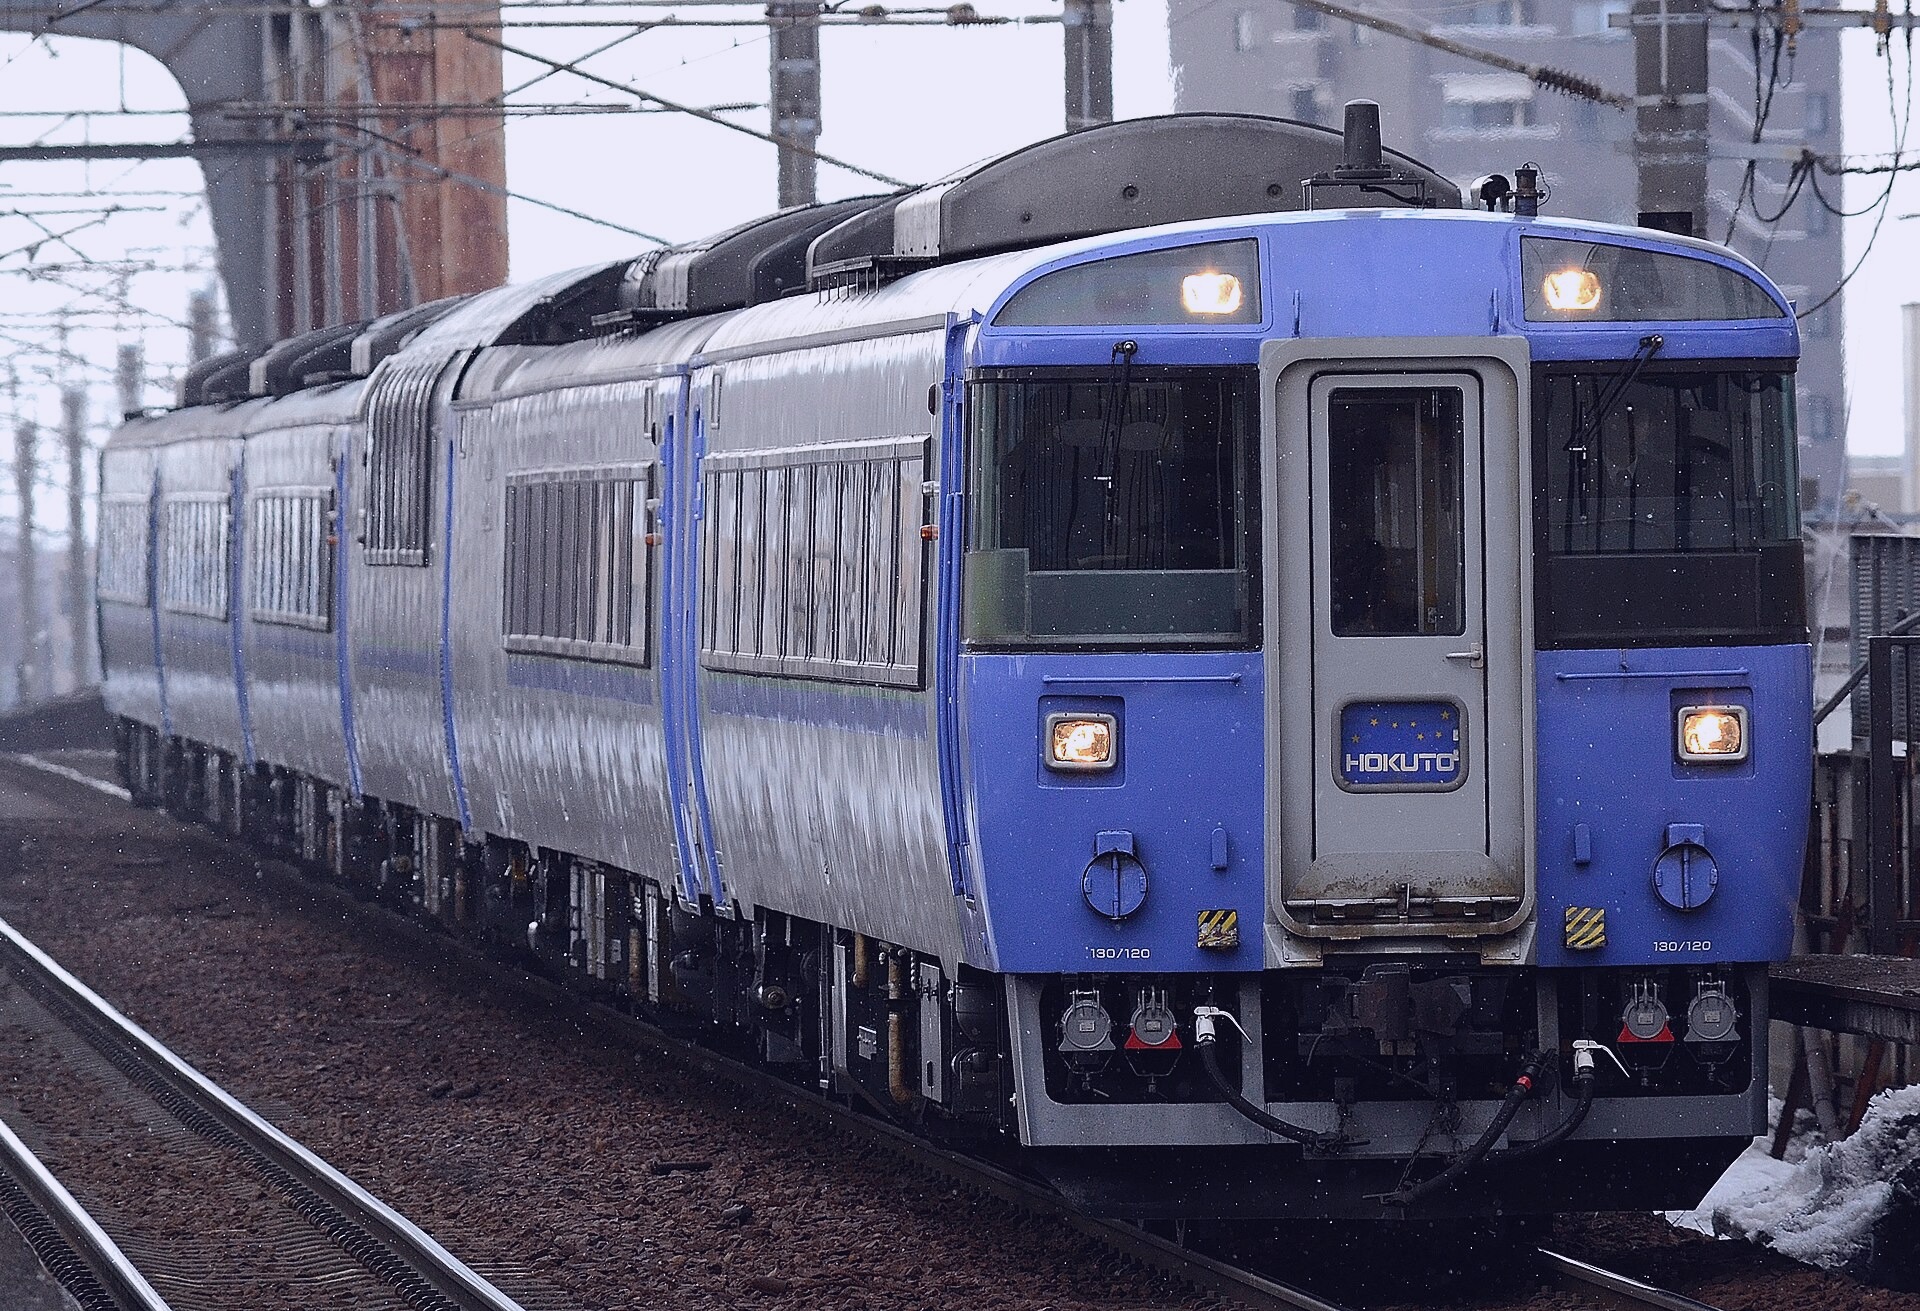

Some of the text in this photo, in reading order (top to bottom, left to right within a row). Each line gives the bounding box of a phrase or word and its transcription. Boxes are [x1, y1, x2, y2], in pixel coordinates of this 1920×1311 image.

[1346, 753, 1454, 772] HOKUTO
[1653, 941, 1711, 951] 130/120
[1090, 948, 1150, 959] 130/120
